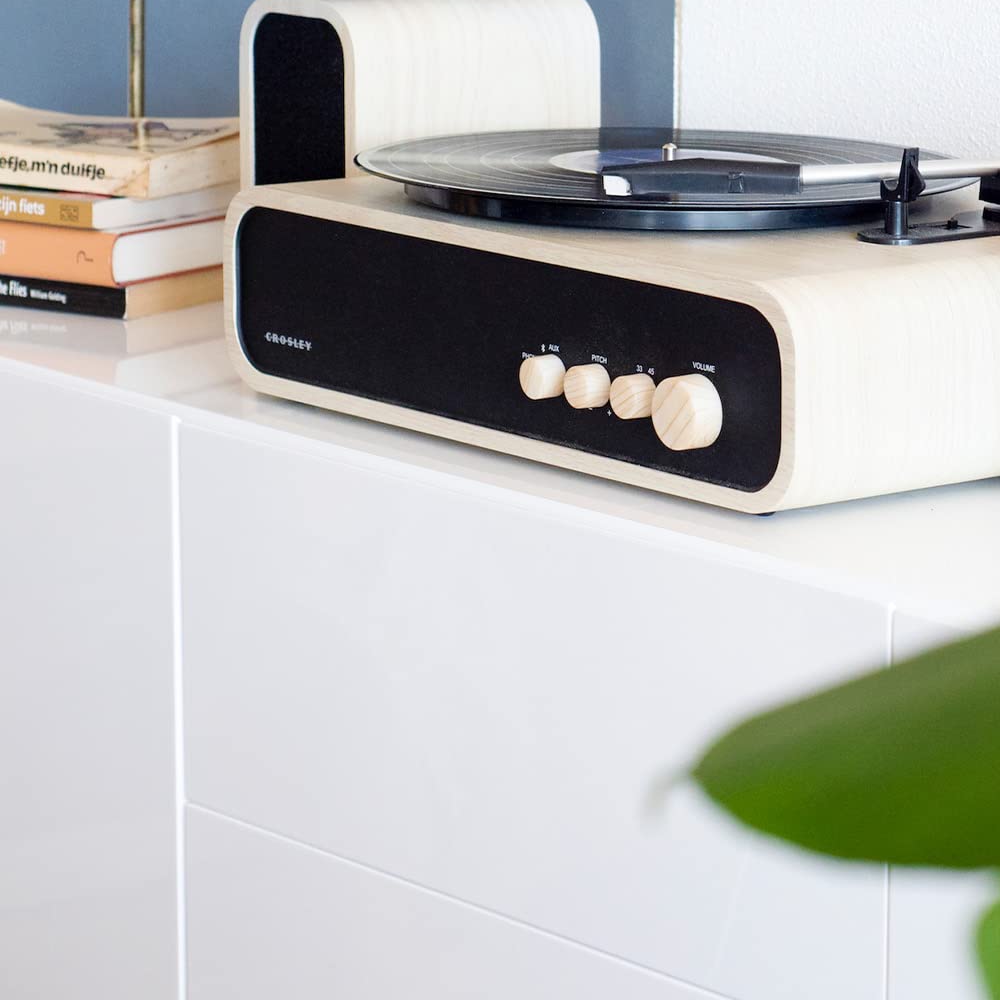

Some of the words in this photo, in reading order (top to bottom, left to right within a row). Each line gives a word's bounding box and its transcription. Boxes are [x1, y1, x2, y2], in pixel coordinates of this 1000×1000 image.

[31, 160, 58, 175] m'n
[60, 162, 106, 180] duifje
[0, 195, 17, 216] ijn
[19, 197, 46, 216] fiets
[264, 331, 312, 351] CROSLEY
[548, 343, 560, 353] AUX
[591, 354, 608, 365] PITCH
[636, 364, 643, 373] 33
[647, 367, 655, 376] 45
[692, 361, 716, 374] VOLUME
